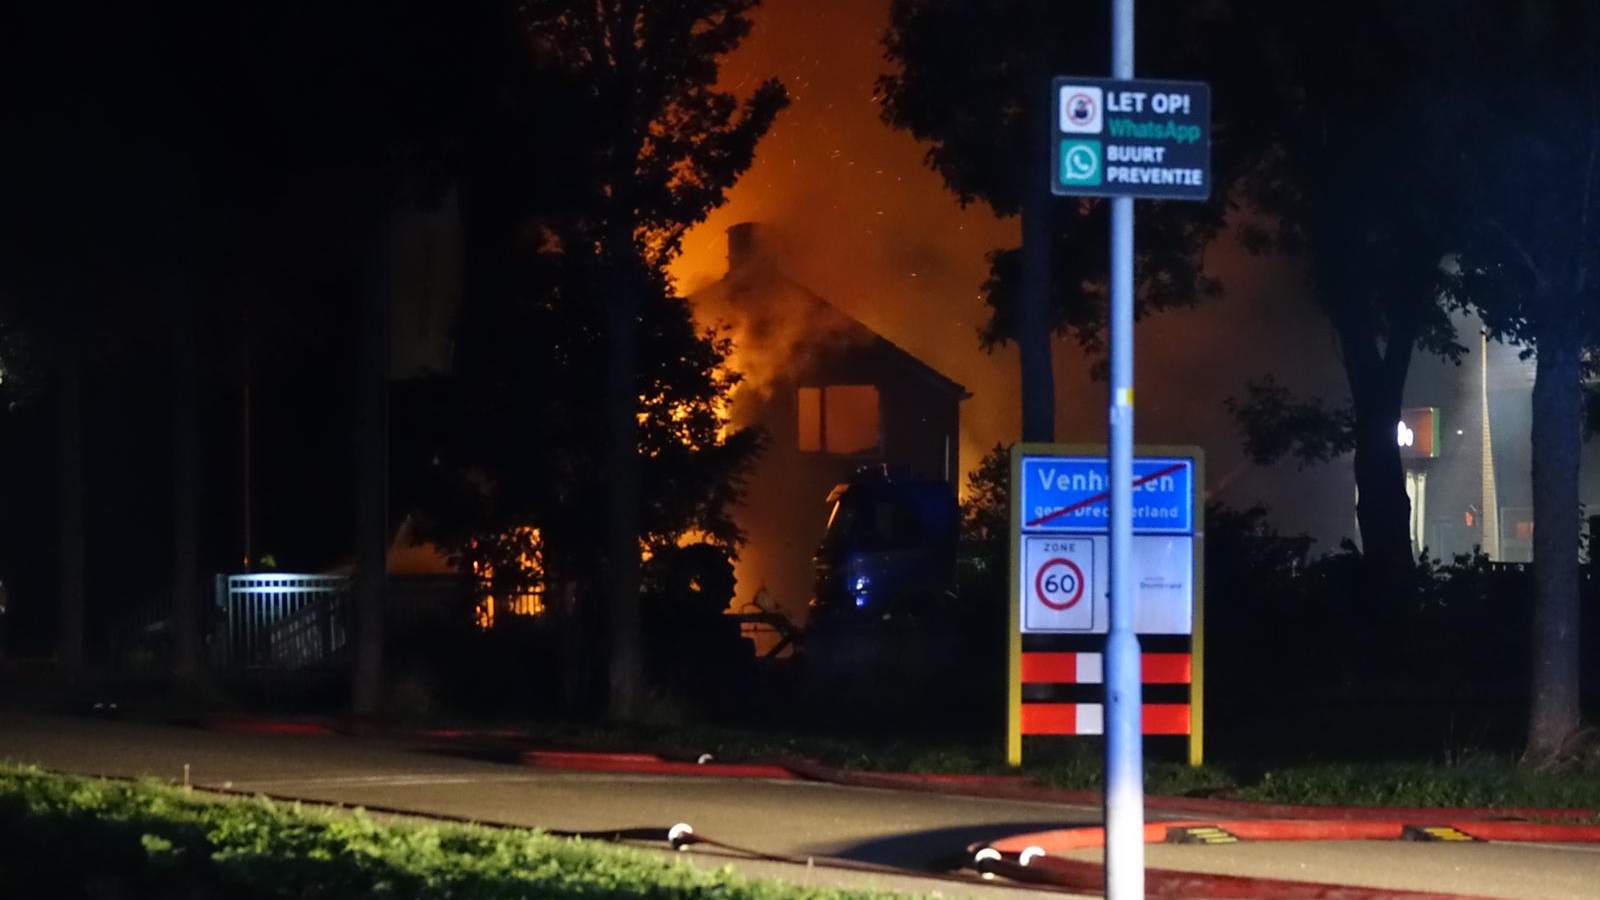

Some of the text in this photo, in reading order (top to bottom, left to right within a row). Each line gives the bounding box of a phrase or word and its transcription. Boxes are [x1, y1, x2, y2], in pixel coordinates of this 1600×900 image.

[1107, 92, 1191, 114] LET OP!
[1108, 119, 1201, 143] WhatsApp
[1107, 145, 1165, 163] BUURT
[1107, 166, 1203, 186] PREVENTIE
[1038, 468, 1174, 492] Venhzen
[1042, 543, 1075, 553] ZONE
[1044, 574, 1075, 594] 60
